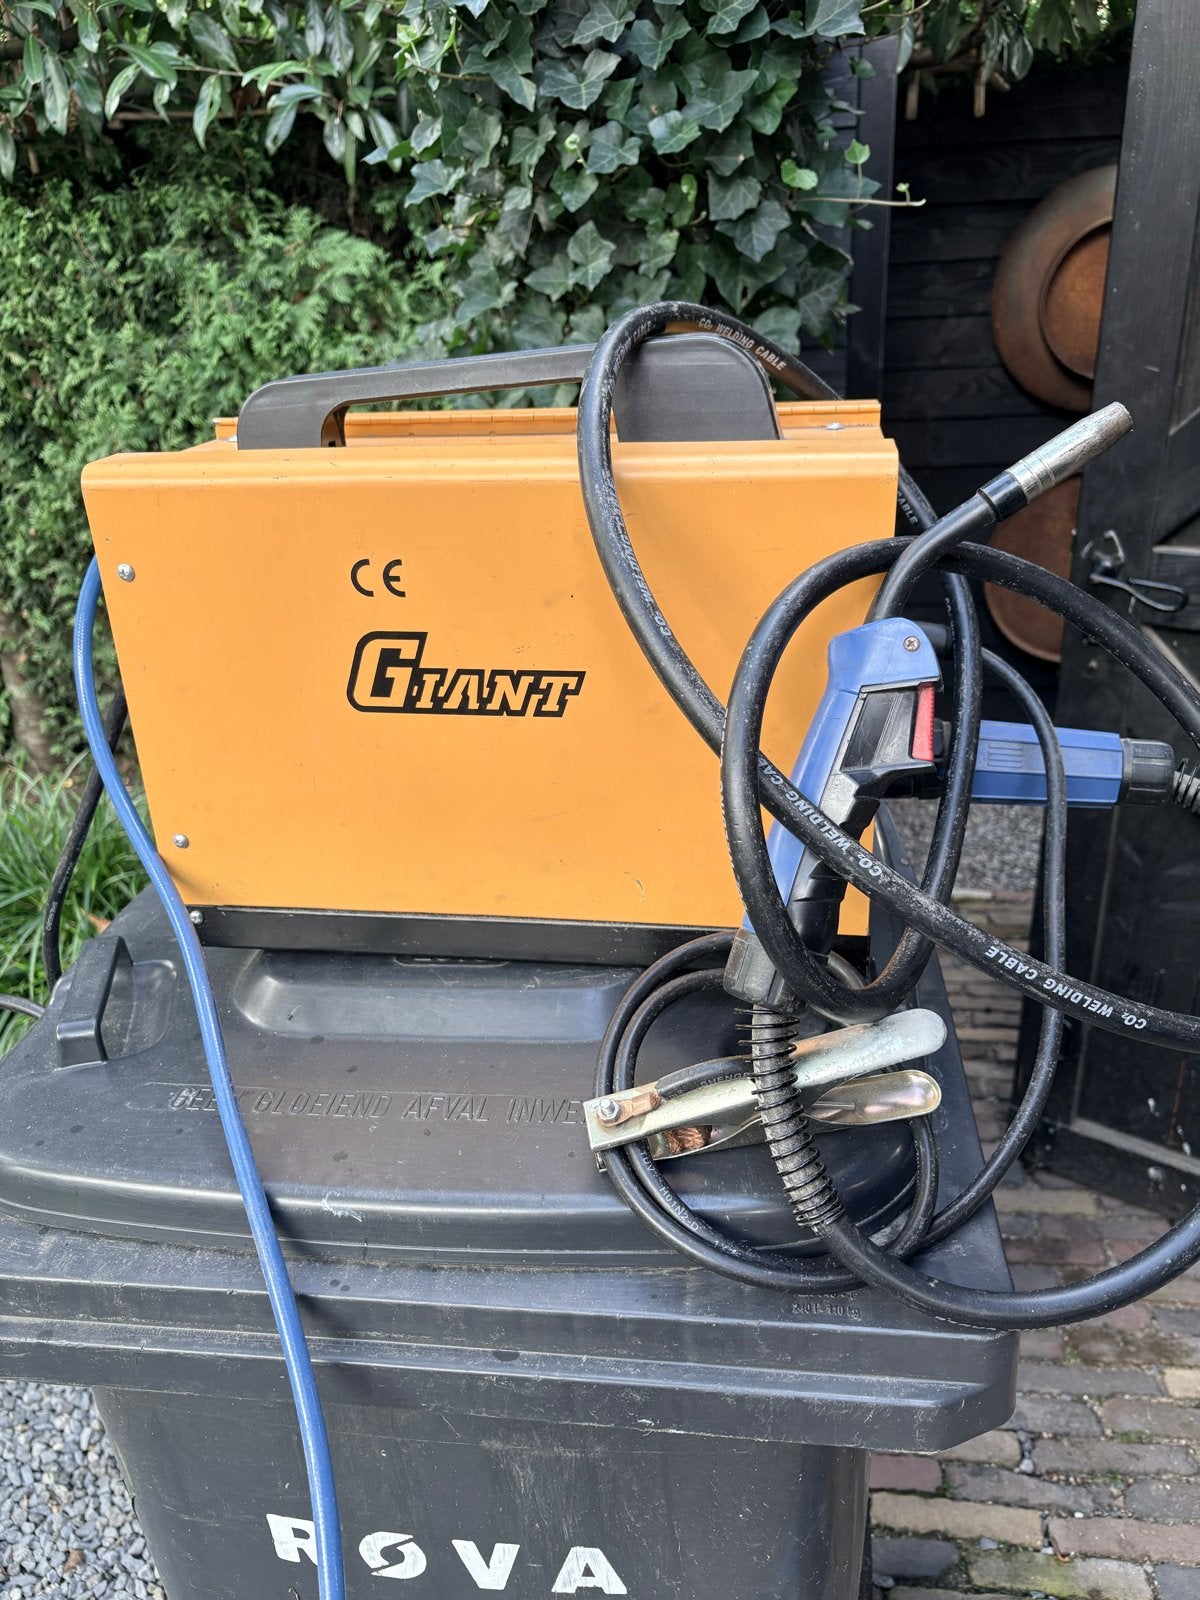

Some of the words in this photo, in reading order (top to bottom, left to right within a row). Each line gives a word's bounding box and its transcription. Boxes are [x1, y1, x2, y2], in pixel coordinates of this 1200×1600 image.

[716, 322, 754, 350] WELDING
[756, 345, 787, 371] CABLE
[351, 558, 406, 597] CE
[346, 630, 587, 718] GIANT
[785, 790, 852, 851] WELDING
[984, 945, 1039, 980] CABLE
[1042, 978, 1114, 1018] WELDING
[252, 1091, 394, 1118] GLOEIEND
[401, 1094, 490, 1122] AFVAL
[505, 1098, 587, 1125] INWE
[660, 1186, 700, 1231] H01N2-D
[266, 1513, 628, 1595] ROVA
